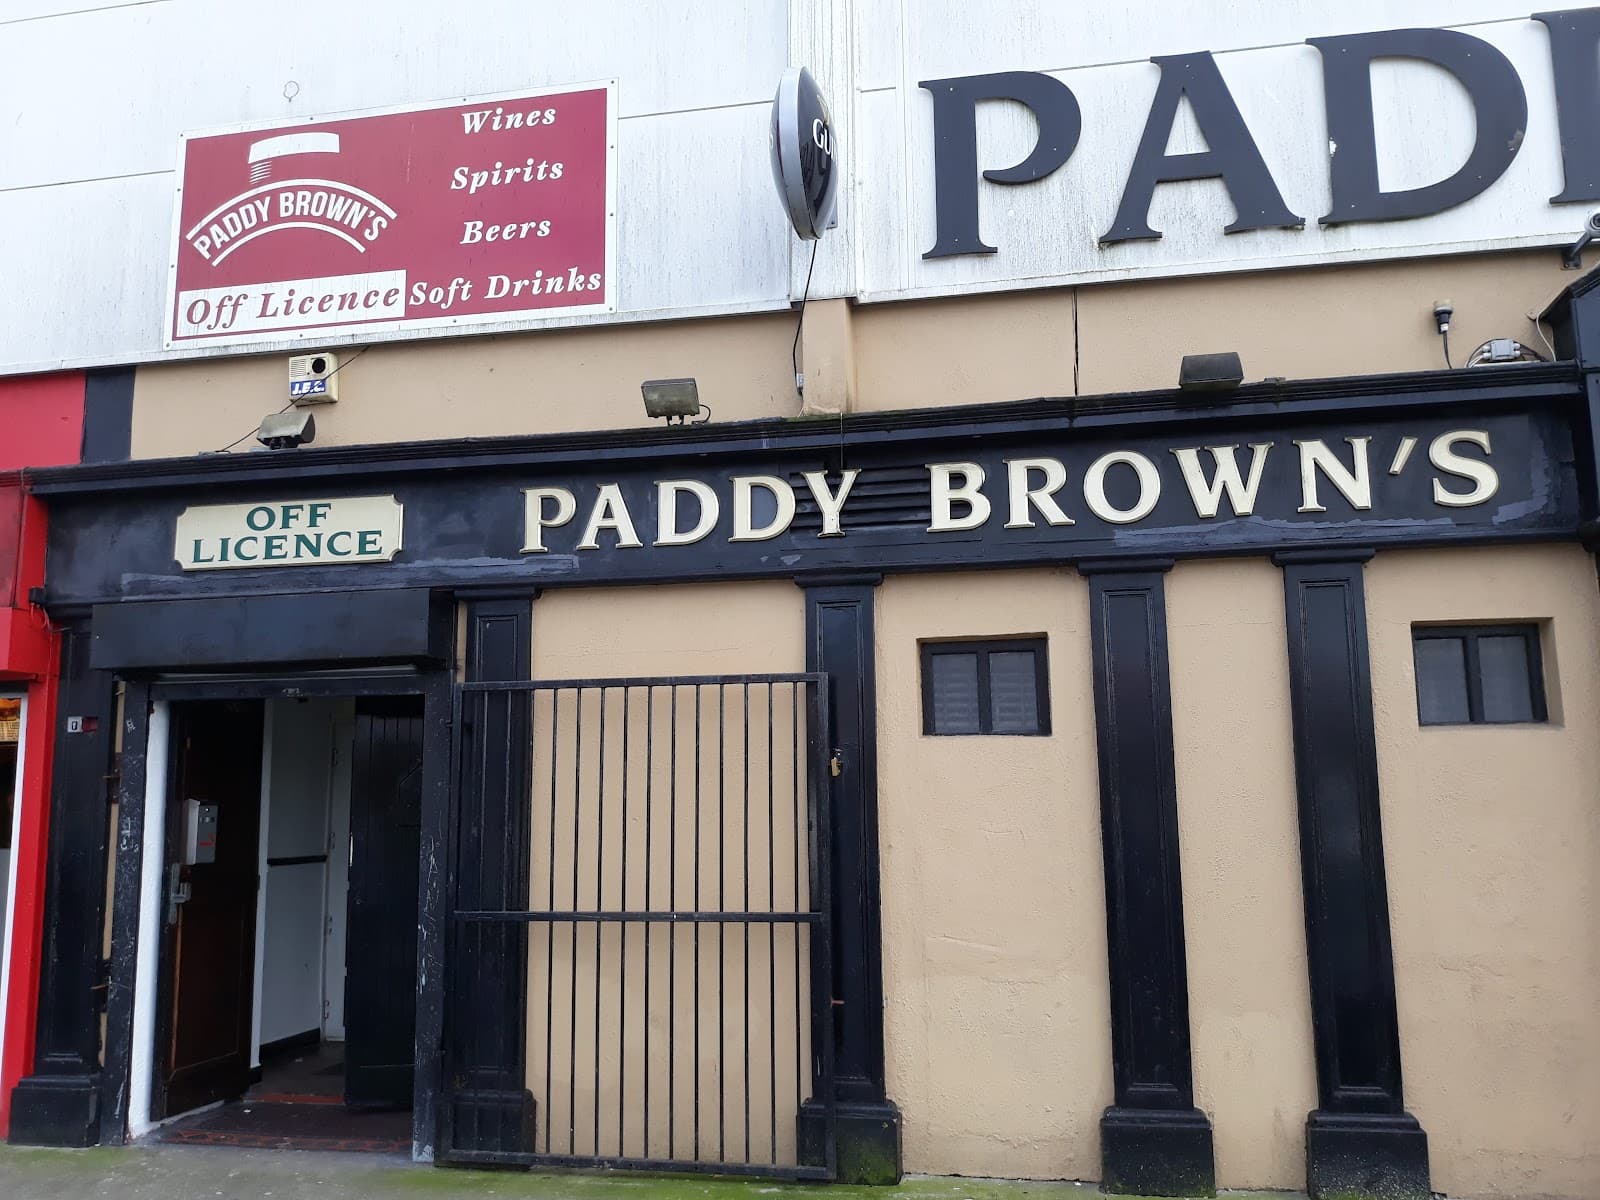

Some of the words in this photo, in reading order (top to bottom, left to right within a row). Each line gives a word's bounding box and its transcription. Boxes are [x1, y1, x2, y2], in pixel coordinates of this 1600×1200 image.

[461, 106, 557, 135] Wines
[450, 157, 564, 194] Spirits
[193, 196, 271, 260] PADDY
[279, 190, 388, 241] BROWN'S
[460, 218, 552, 245] Beers
[409, 277, 473, 308] Soft
[484, 266, 602, 300] Drinks
[186, 293, 249, 331] Off
[256, 284, 400, 319] Licence
[519, 468, 862, 553] PADDY
[925, 429, 1501, 533] BROWN'S
[246, 503, 332, 532] OFF
[191, 530, 383, 564] LICENCE
